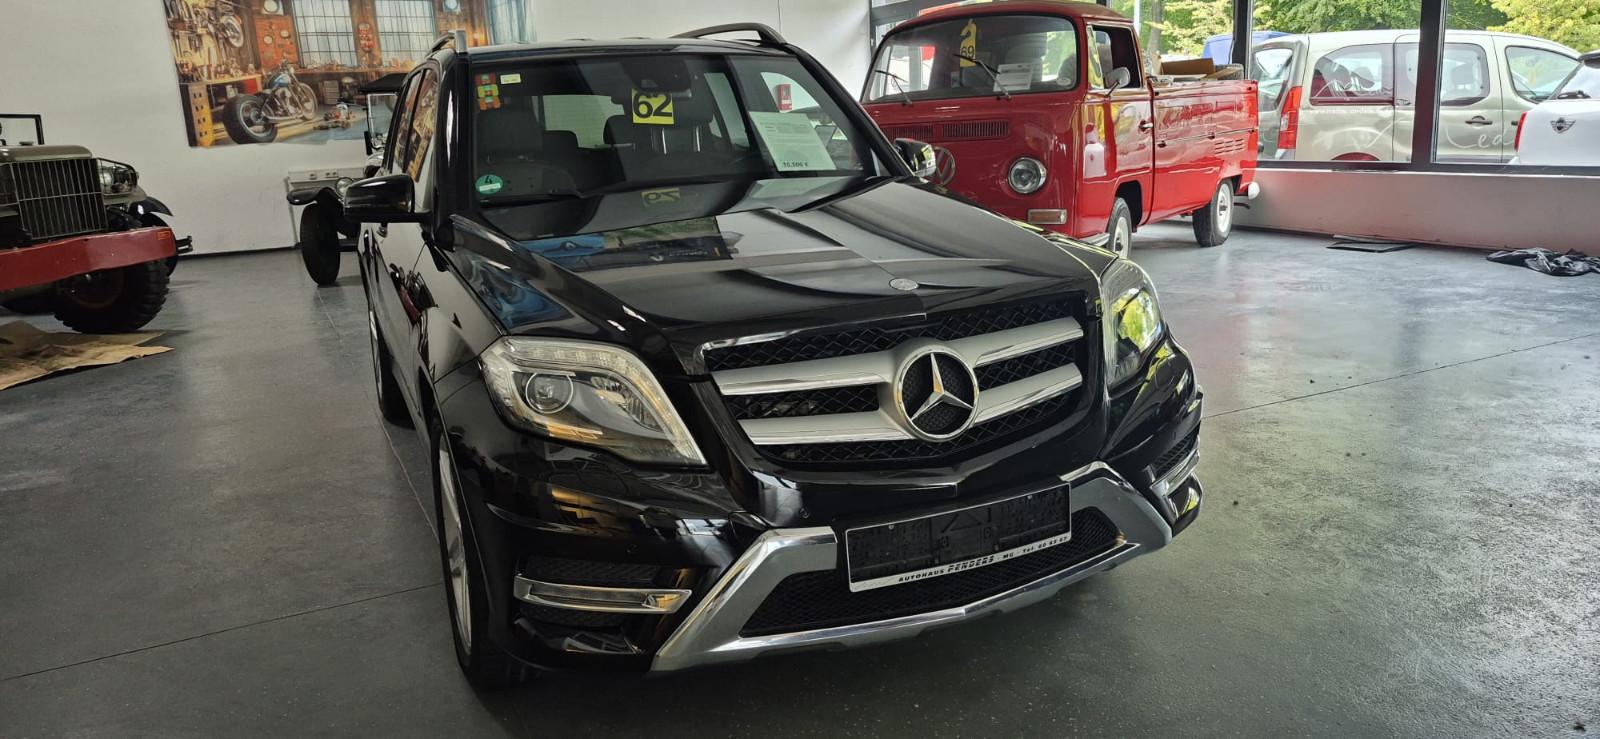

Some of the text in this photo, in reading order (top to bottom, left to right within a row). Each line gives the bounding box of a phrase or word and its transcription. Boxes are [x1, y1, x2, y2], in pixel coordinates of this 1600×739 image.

[961, 45, 974, 59] 69
[633, 93, 673, 119] 62
[484, 175, 493, 184] 4
[898, 568, 945, 582] AUTOHAUS
[947, 555, 994, 572] PENDERS
